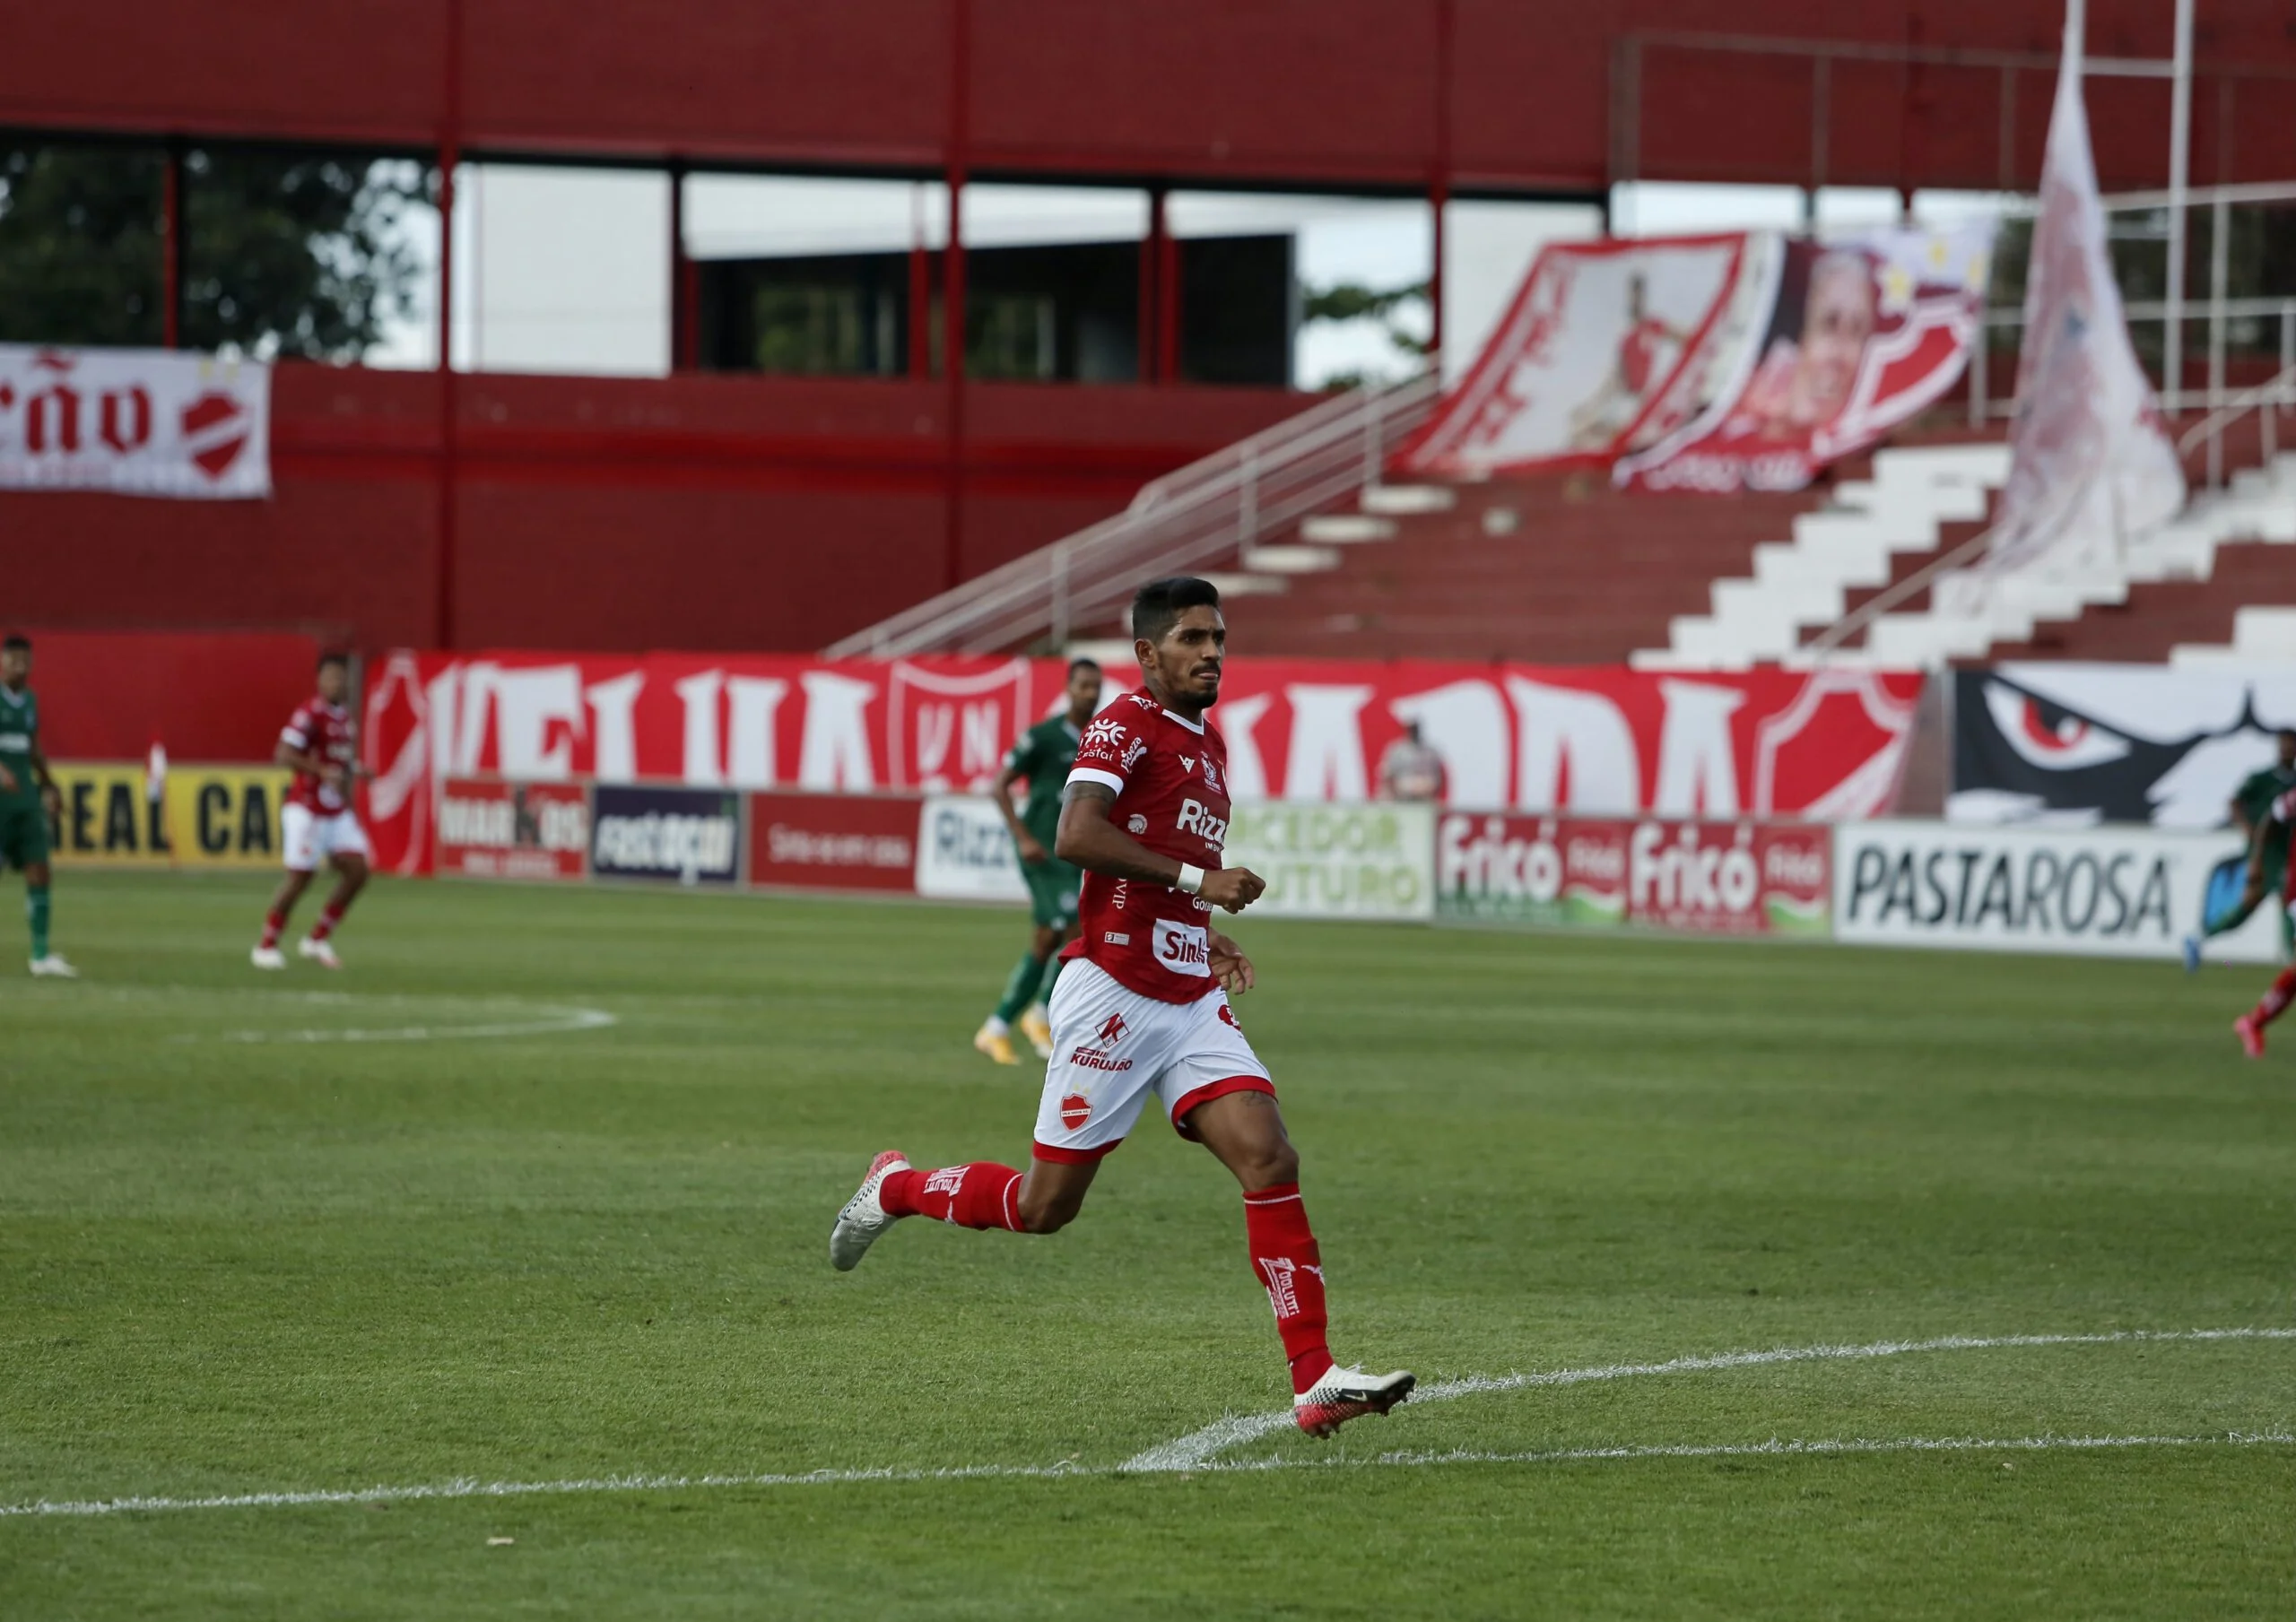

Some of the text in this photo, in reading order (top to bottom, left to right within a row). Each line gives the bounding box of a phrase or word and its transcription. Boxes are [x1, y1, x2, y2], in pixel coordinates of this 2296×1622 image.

[51, 780, 290, 854] EAL CA
[1846, 843, 2172, 938] PASTAROSA
[1070, 1052, 1134, 1072] KURUJÃO
